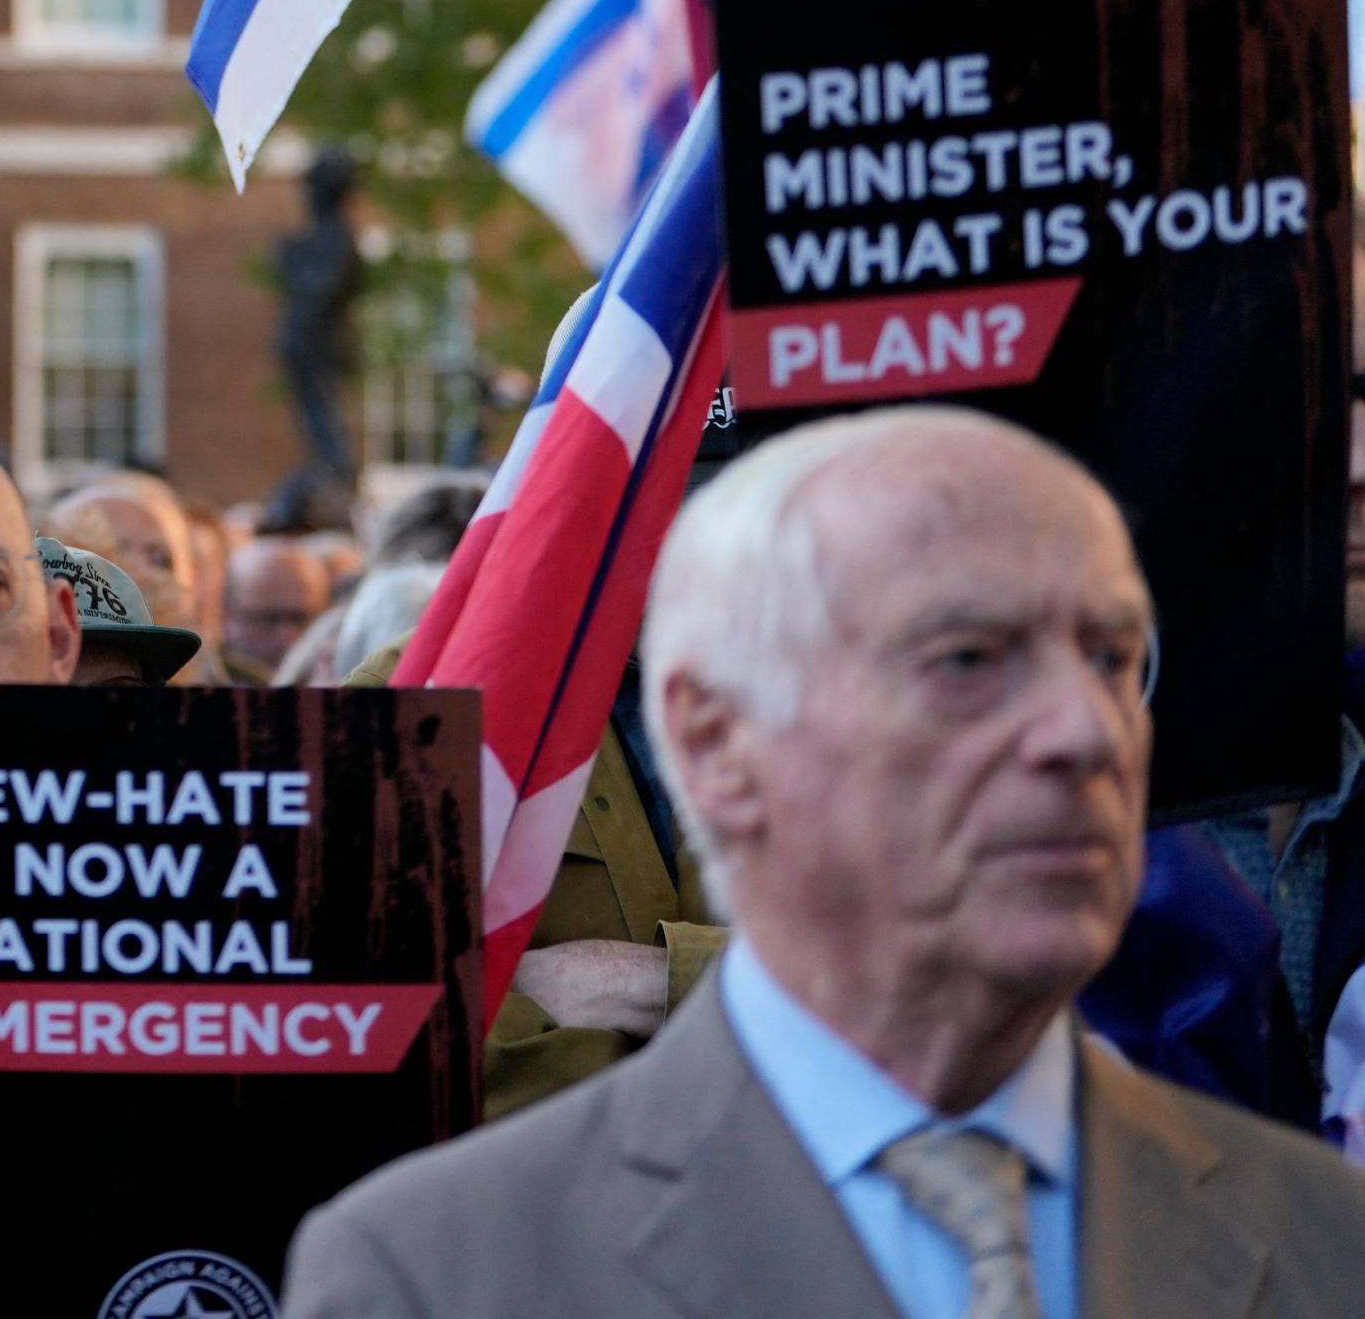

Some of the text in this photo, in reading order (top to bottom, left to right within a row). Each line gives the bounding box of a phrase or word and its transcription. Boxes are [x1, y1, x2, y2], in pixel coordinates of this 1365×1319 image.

[760, 53, 992, 133] PRIME
[763, 122, 1133, 213] MINISTER,
[767, 176, 1308, 293] WHAT IS YOUR
[771, 304, 1025, 389] PLAN?
[14, 844, 202, 898] NOW
[222, 845, 278, 898] A
